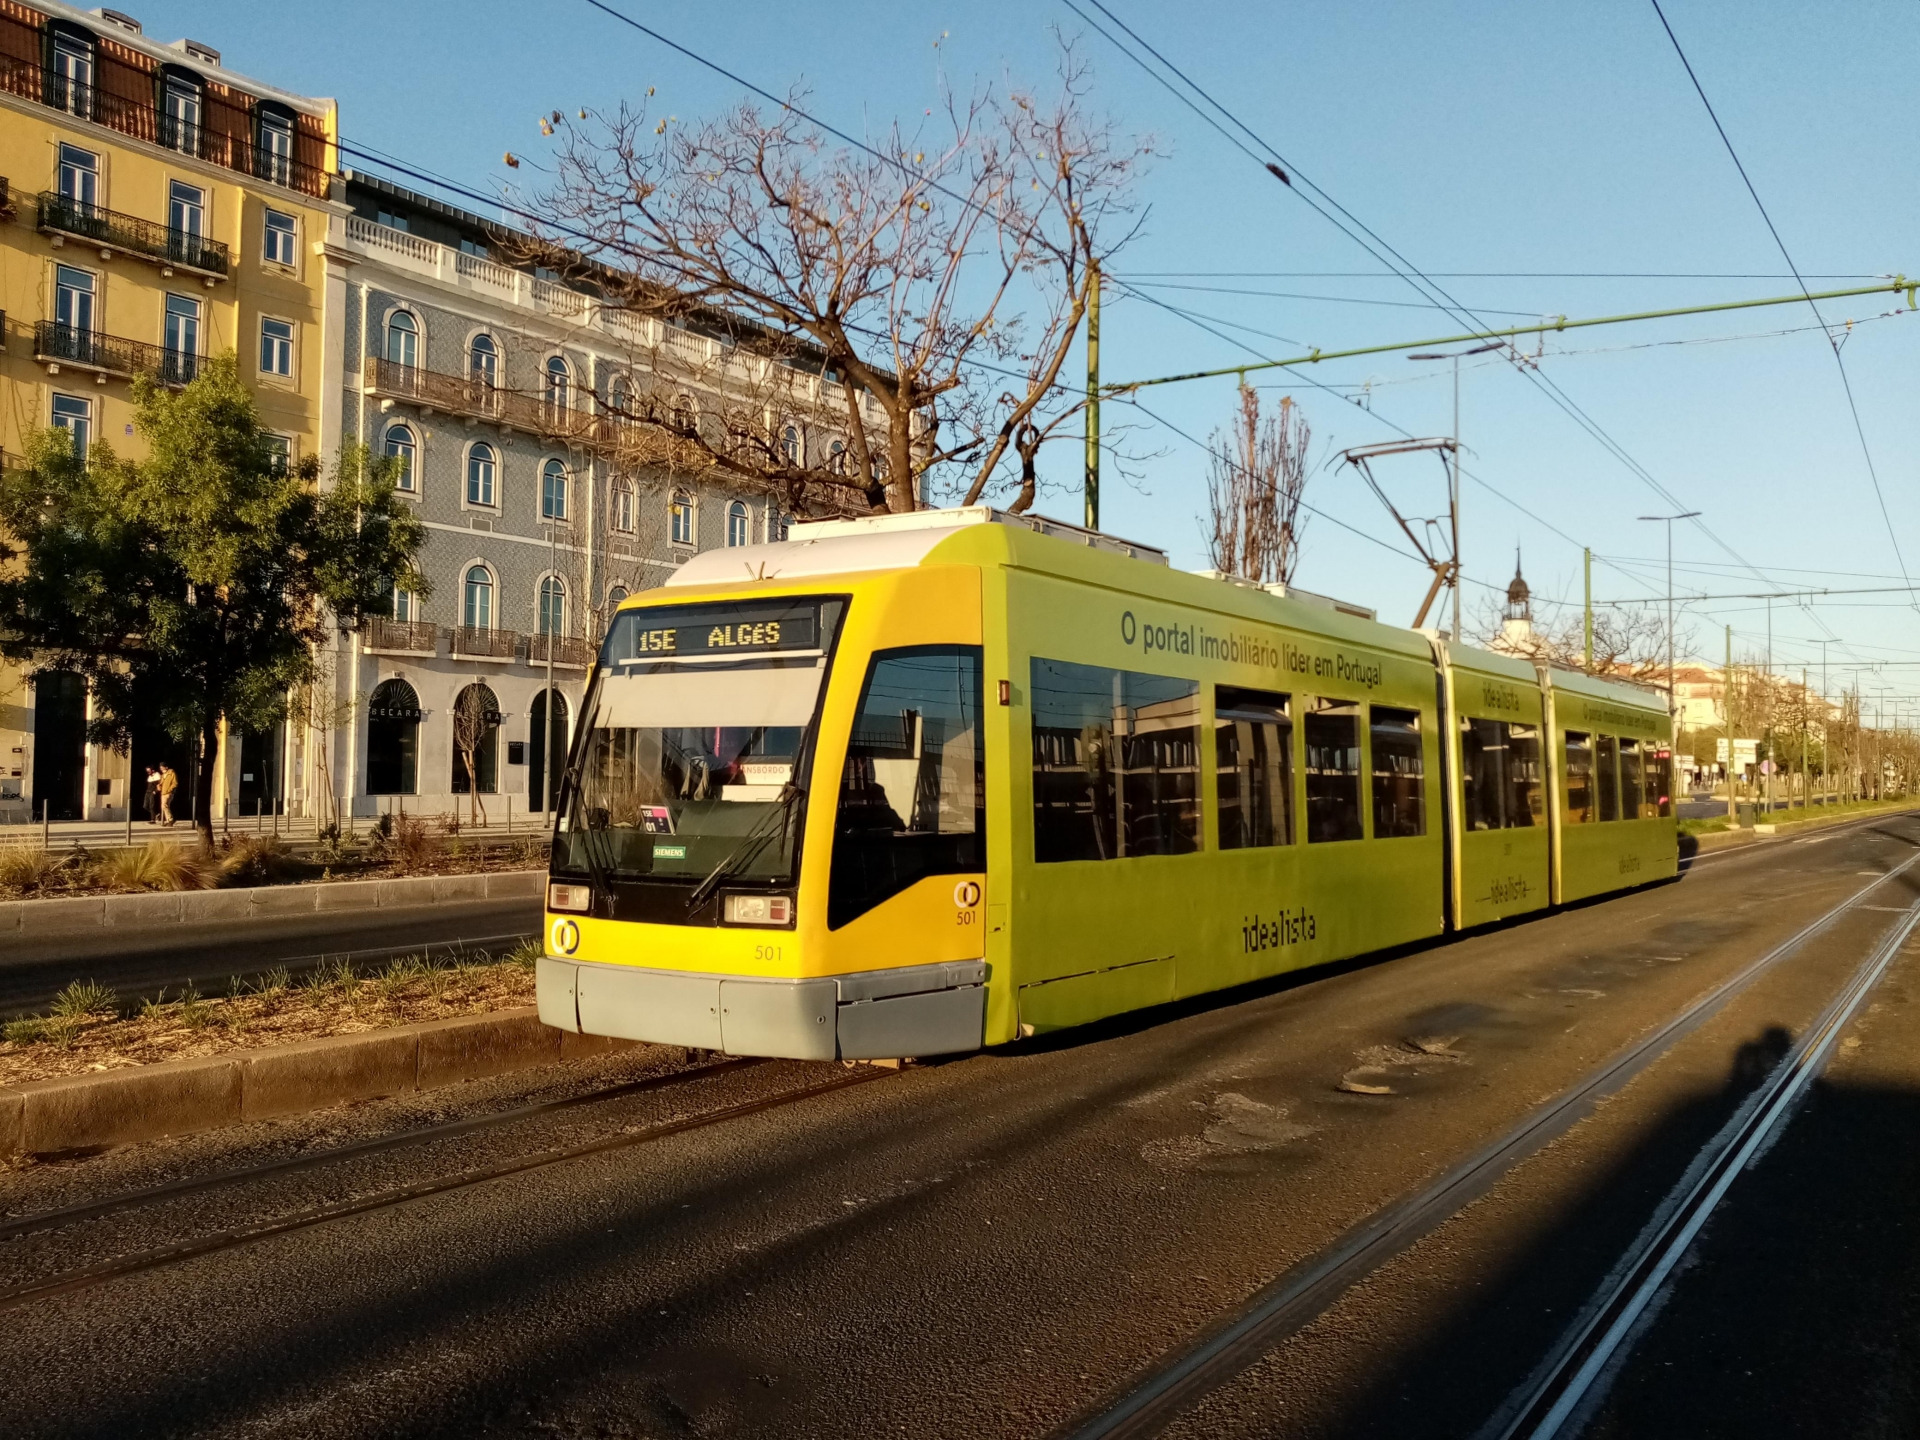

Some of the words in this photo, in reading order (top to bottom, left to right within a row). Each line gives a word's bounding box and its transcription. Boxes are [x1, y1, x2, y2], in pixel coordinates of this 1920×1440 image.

[639, 629, 677, 652] 15E
[1121, 610, 1136, 645] O
[1143, 622, 1195, 655] portal
[1199, 627, 1278, 669] imobiliário
[1281, 642, 1310, 674] líder
[1314, 656, 1333, 678] em
[1336, 653, 1382, 690] Portugal
[371, 708, 420, 717] BECARA
[742, 766, 785, 774] ANSBORDO
[646, 822, 656, 832] 01
[654, 848, 684, 857] SIEMENS
[957, 910, 977, 926] 501
[1243, 906, 1316, 954] idealista
[754, 945, 782, 961] 501
